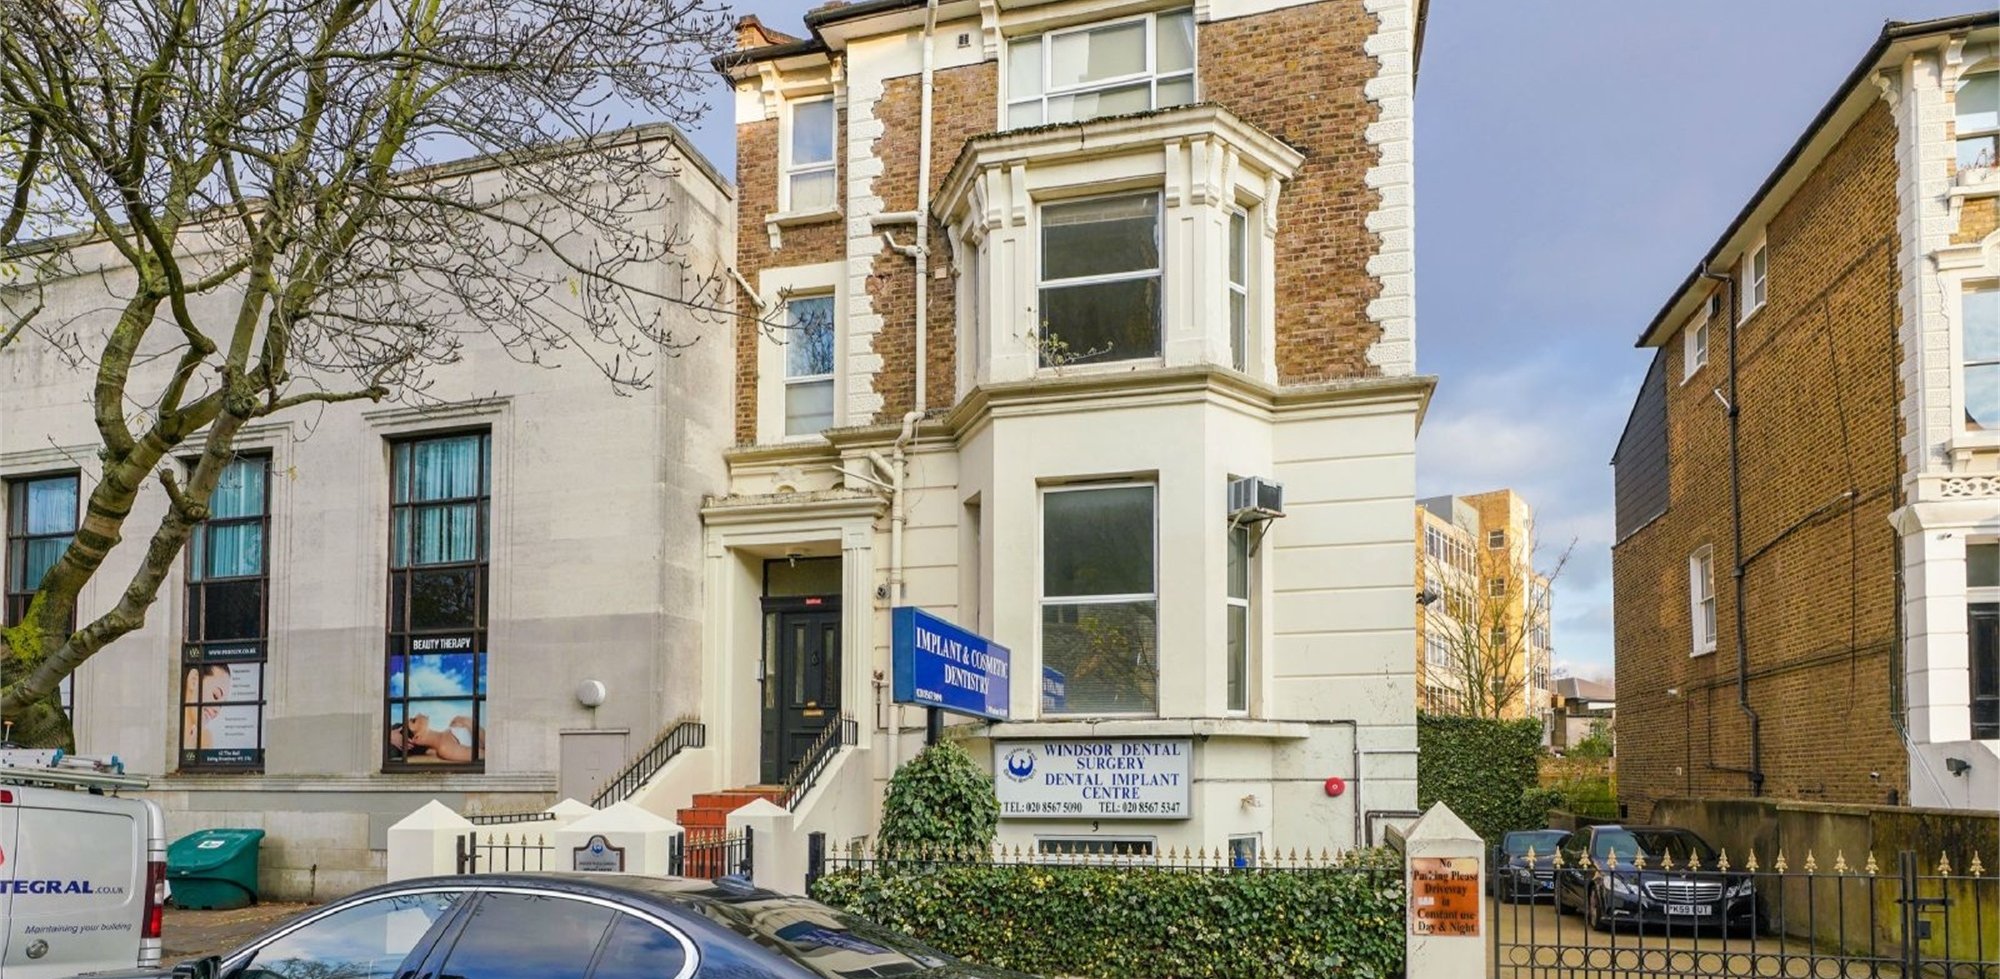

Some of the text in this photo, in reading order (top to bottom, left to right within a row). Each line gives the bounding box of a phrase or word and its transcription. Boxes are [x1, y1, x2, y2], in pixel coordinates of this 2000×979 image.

[413, 637, 471, 650] BEAUTY THERAPY
[916, 627, 1008, 679] IMPLANT & COSMETIC
[944, 663, 989, 694] DENTISTRY
[1044, 743, 1181, 756] WINDSOR DENTAL
[1077, 756, 1145, 770] SURGERY
[1045, 773, 1180, 786] DENTAL IMPLANT
[1082, 786, 1140, 799] CENTRE
[1004, 801, 1180, 813] TEL: 020 8567 5090 TEL: 020 8567 5347
[1440, 859, 1452, 868] No
[1451, 871, 1478, 881] Please
[1424, 883, 1467, 896] Driveway
[1441, 898, 1450, 906] in
[1417, 908, 1476, 920] Constant use
[25, 923, 132, 935] Maintaining your building
[1418, 921, 1475, 934] Day & Night
